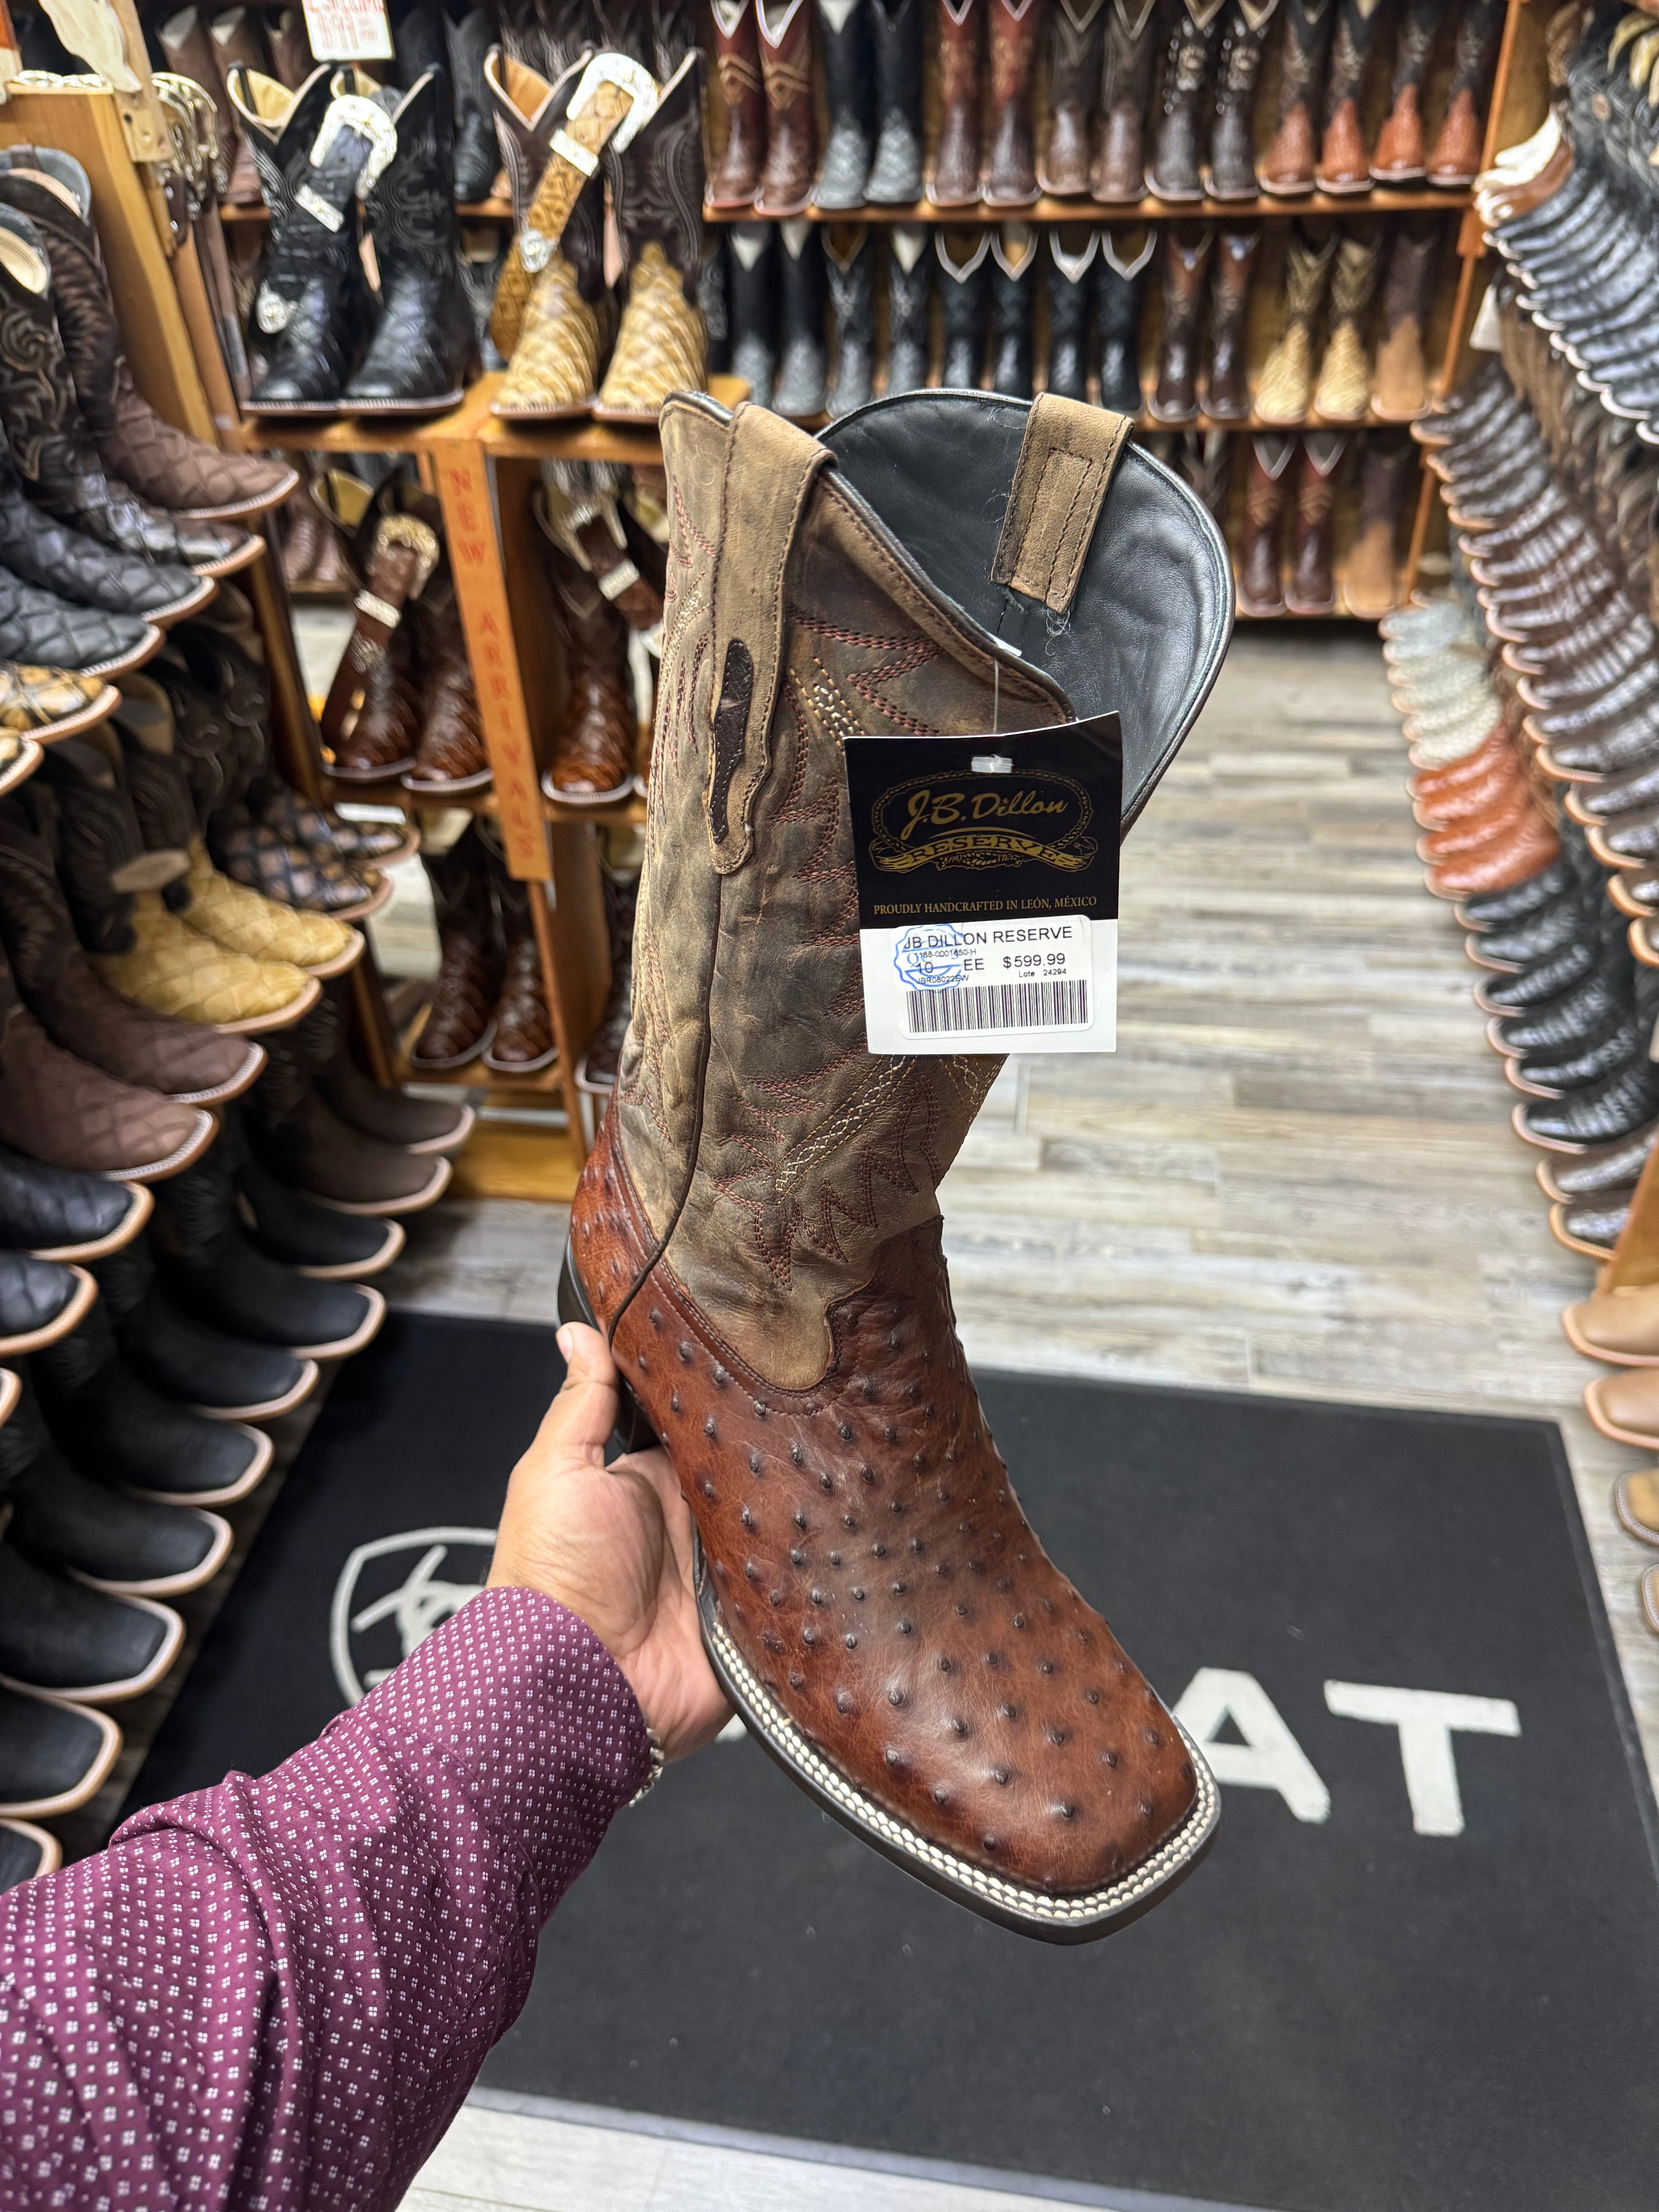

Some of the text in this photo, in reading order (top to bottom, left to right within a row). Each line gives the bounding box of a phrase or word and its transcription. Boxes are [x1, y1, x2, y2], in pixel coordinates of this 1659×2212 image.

[448, 467, 486, 565] NEW
[477, 611, 535, 860] ARRIVALS
[971, 790, 1068, 820] Dillon
[907, 835, 1061, 863] RESERVE
[874, 895, 1097, 915] PROUDLY HANDCRAFTED IN LEÓN, MÉXICO
[904, 926, 1072, 949] JB DILLON RESERVE
[916, 953, 1065, 973] 10 EE $599.99
